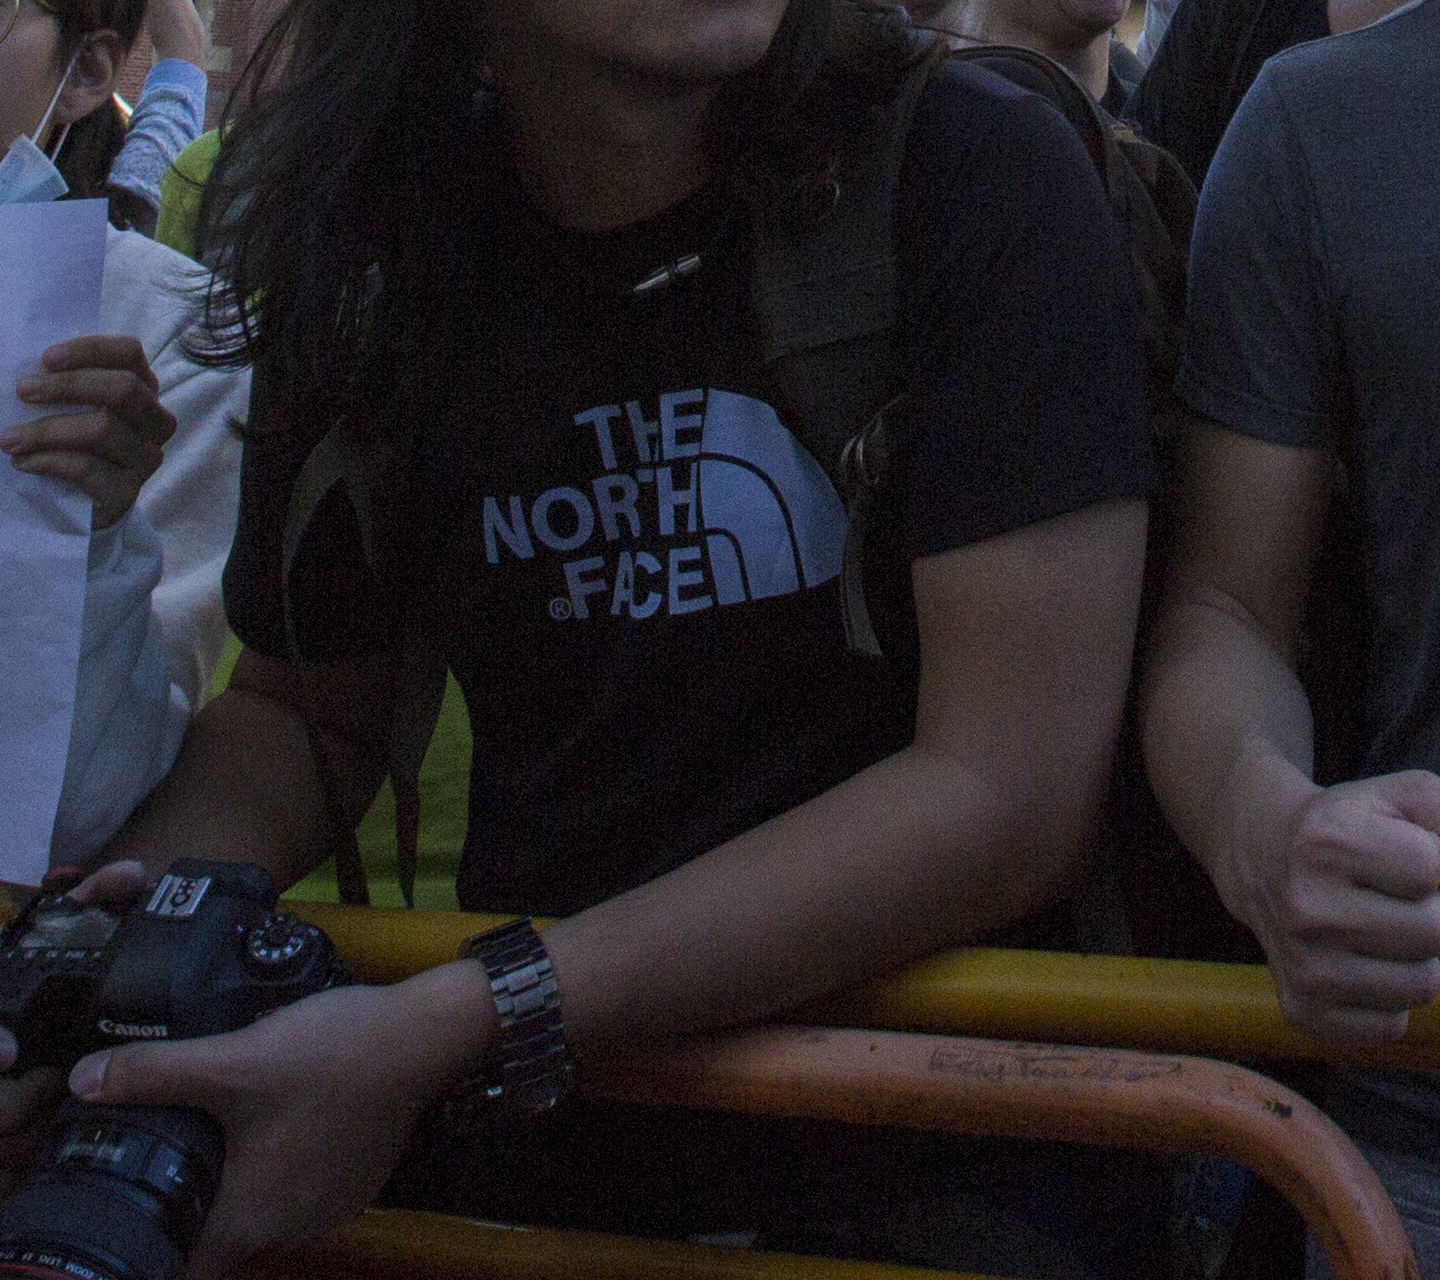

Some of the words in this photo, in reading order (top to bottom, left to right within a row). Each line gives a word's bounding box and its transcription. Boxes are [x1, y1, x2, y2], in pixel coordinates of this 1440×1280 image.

[573, 387, 704, 470] THE
[481, 460, 699, 564] NORTH
[562, 546, 714, 620] FACE
[96, 1017, 169, 1038] Canon
